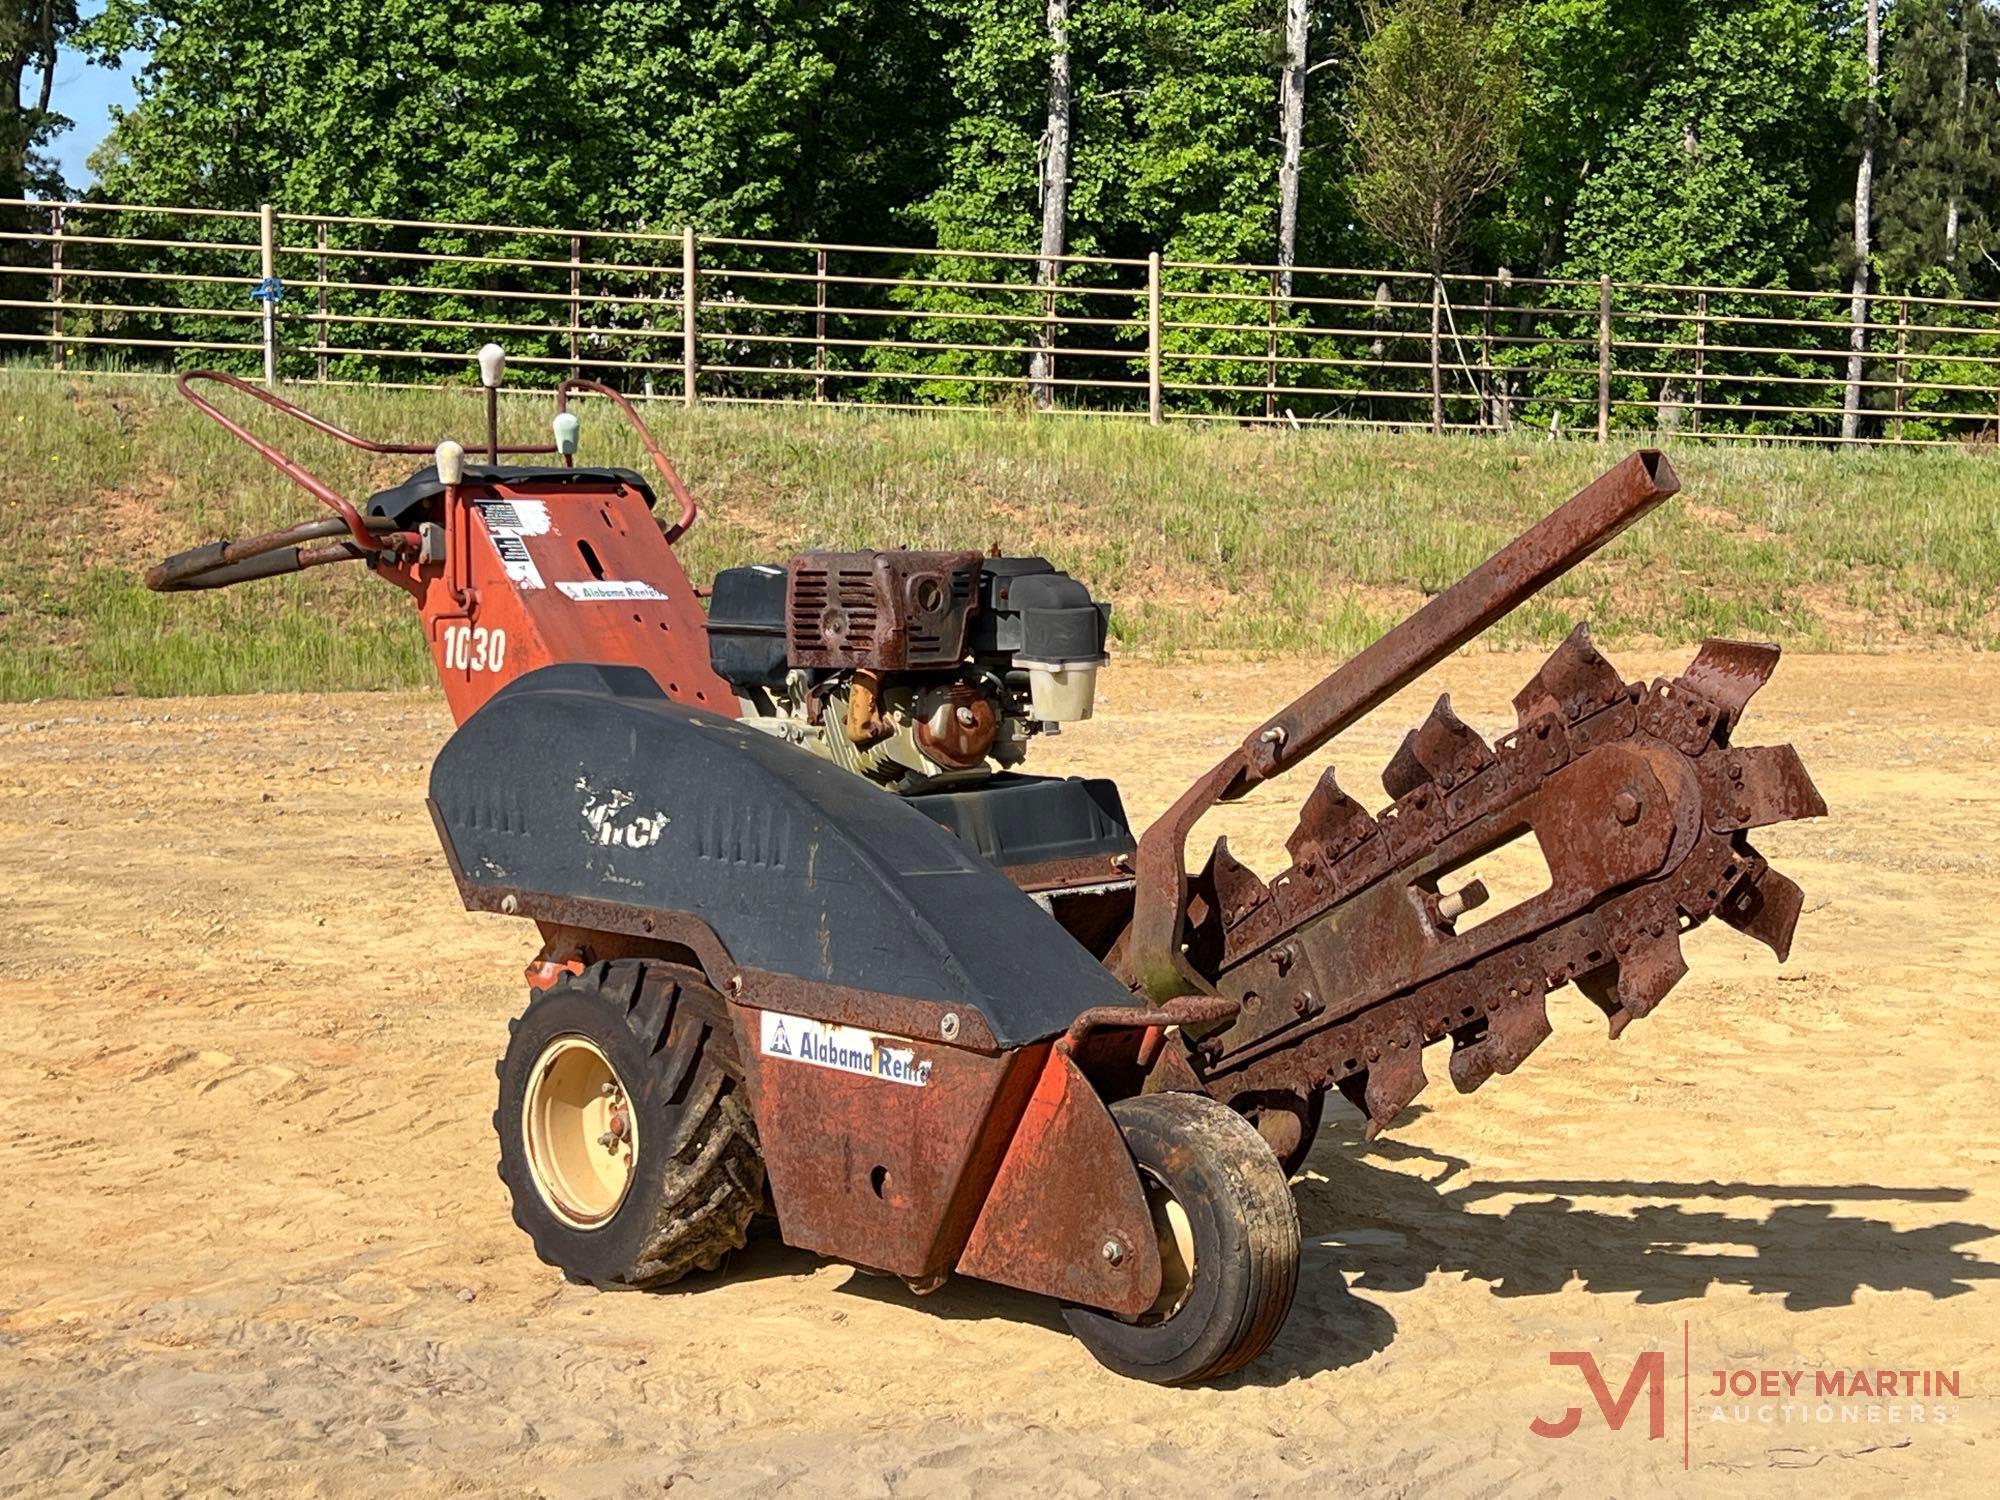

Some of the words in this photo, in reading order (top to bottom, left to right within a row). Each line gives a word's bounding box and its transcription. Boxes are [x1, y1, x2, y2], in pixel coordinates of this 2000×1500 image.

[583, 587, 625, 598] Alabama
[444, 626, 506, 673] 1030
[799, 1031, 873, 1072] Alabama
